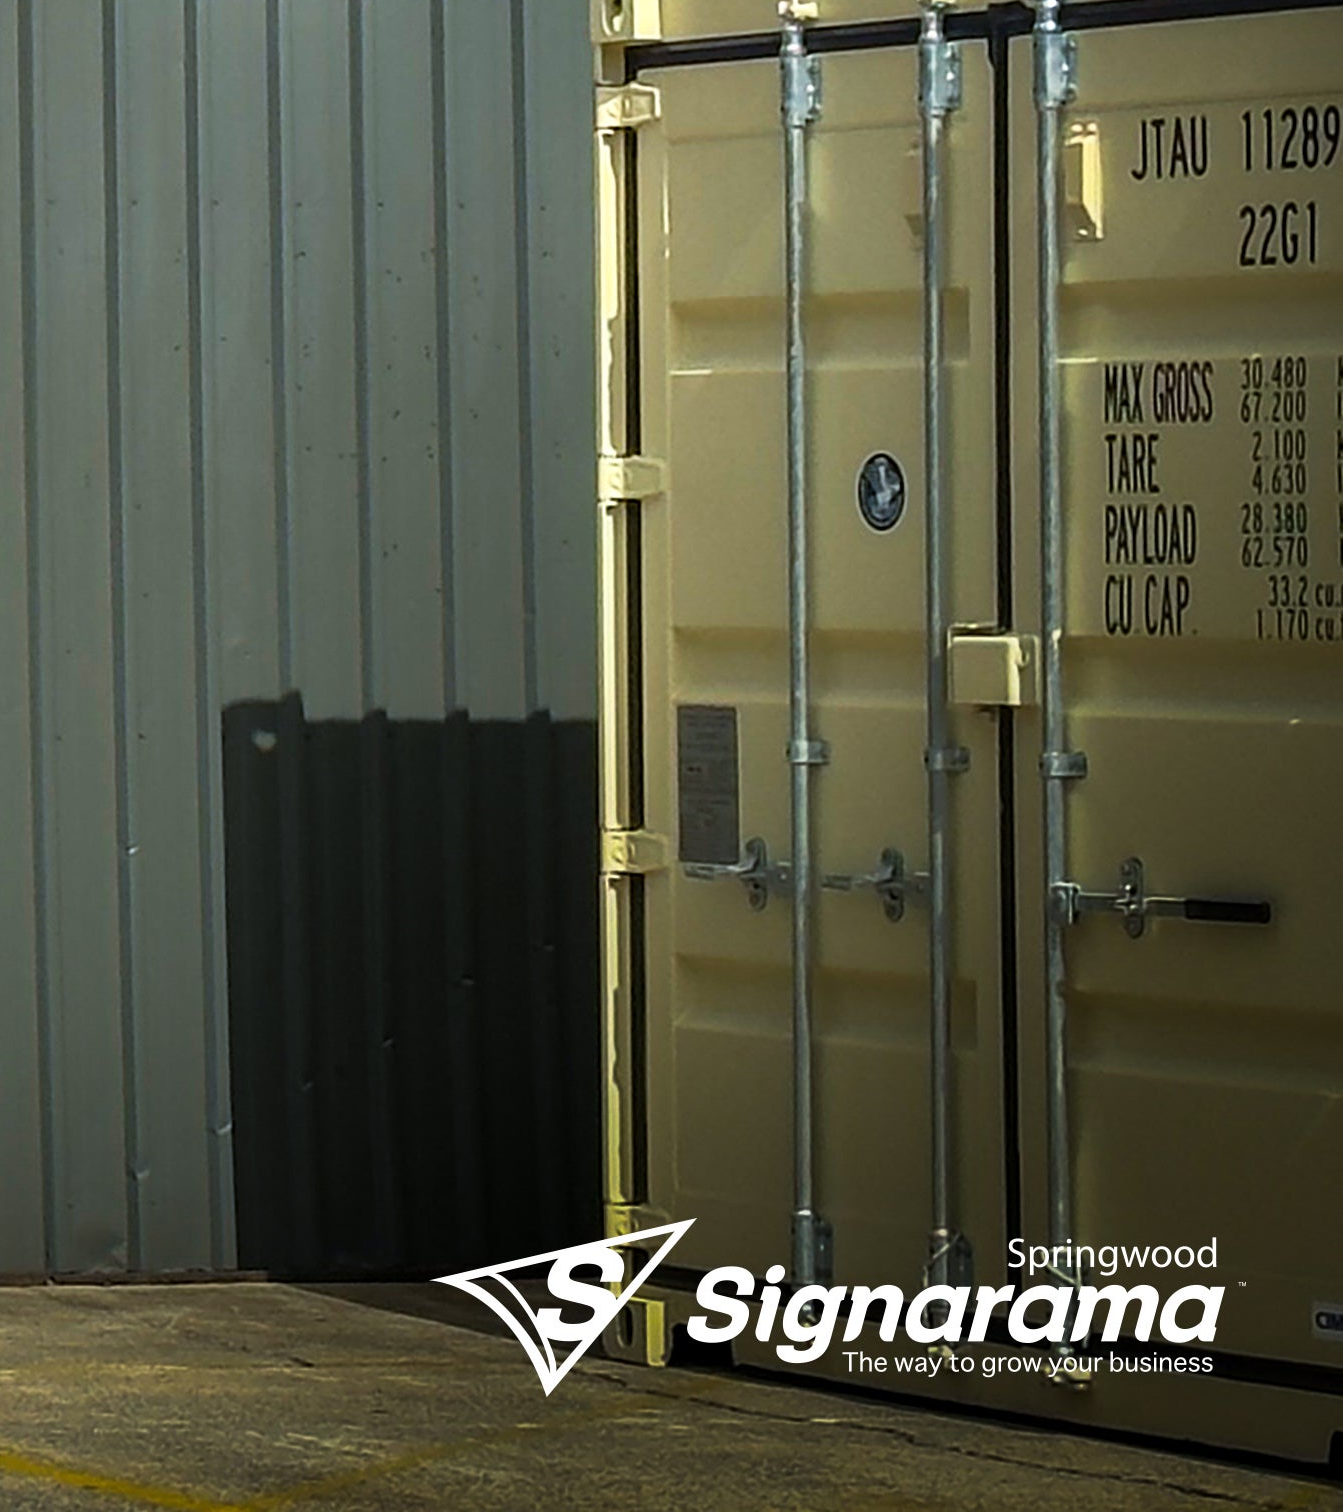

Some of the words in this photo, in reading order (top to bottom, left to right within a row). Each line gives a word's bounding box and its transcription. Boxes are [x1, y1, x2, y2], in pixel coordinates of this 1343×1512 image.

[1131, 116, 1208, 180] JTAU
[1242, 105, 1341, 172] 11289
[1239, 201, 1316, 266] 22G1
[1240, 356, 1307, 390] 30.480
[1104, 363, 1144, 424] MAX
[1153, 361, 1213, 424] GROSS
[1240, 390, 1306, 423] 67.200
[1251, 429, 1306, 462] 2.100
[1104, 433, 1161, 494] TARE
[1251, 463, 1306, 495] 4.630
[1105, 504, 1197, 565] PAYLOAD
[1240, 502, 1308, 535] 28.380
[1241, 536, 1308, 568] 62.570
[1268, 575, 1308, 607] 33.2
[1256, 608, 1309, 641] 1.170
